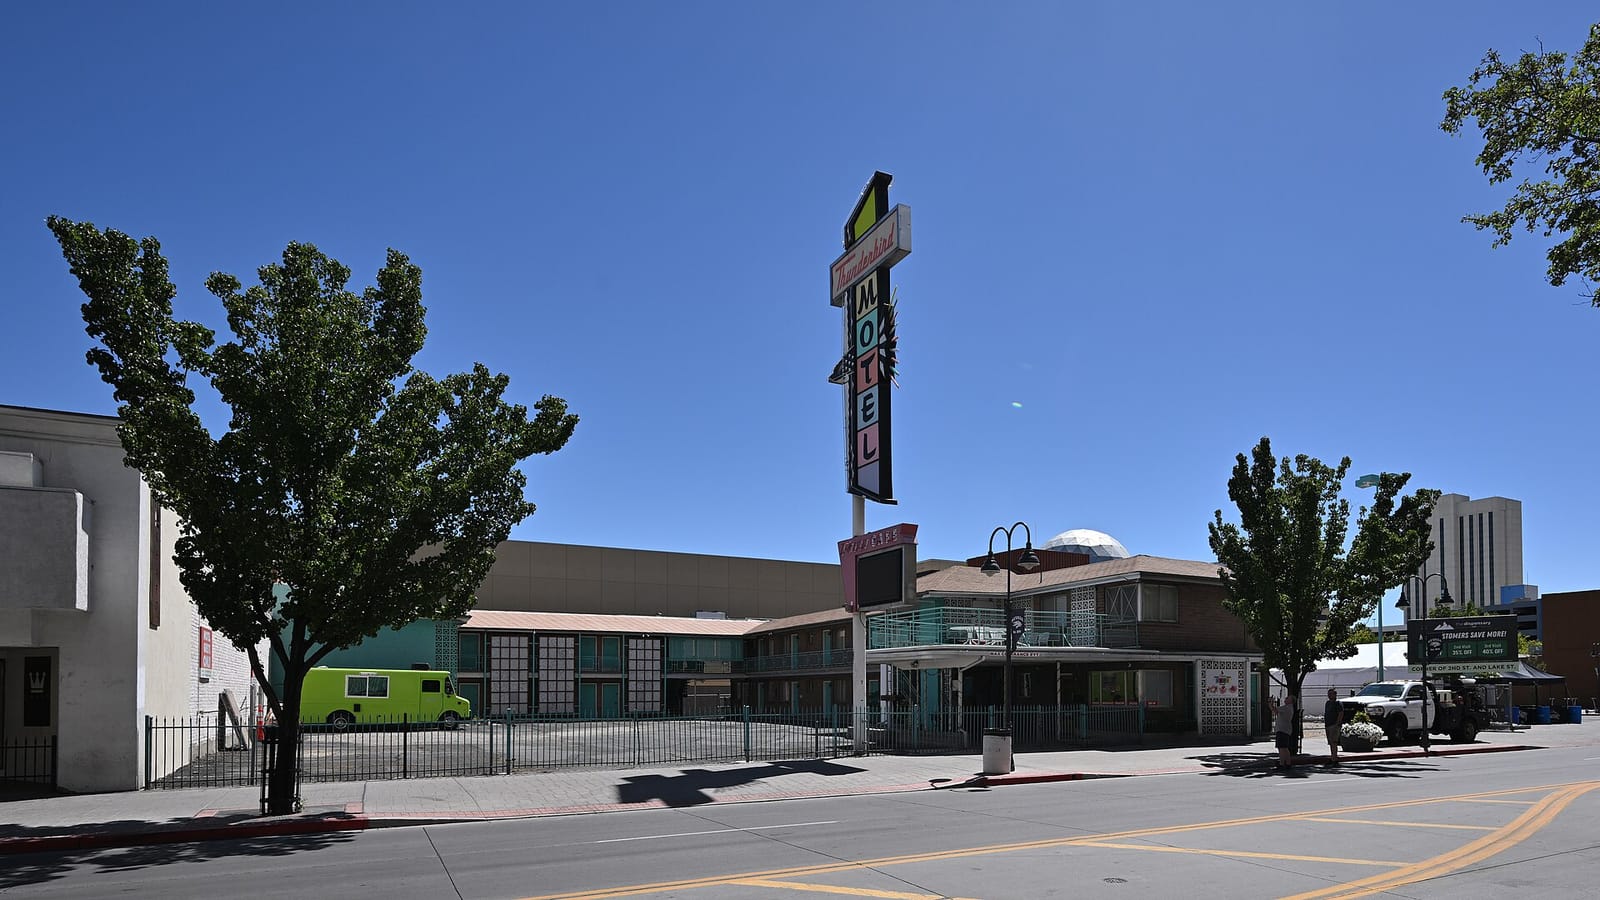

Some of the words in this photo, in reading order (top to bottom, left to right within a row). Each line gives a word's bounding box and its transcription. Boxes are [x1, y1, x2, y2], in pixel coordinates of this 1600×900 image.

[835, 222, 895, 291] Thunderbird
[857, 278, 878, 460] MOTEL
[1442, 632, 1469, 640] STOMERS
